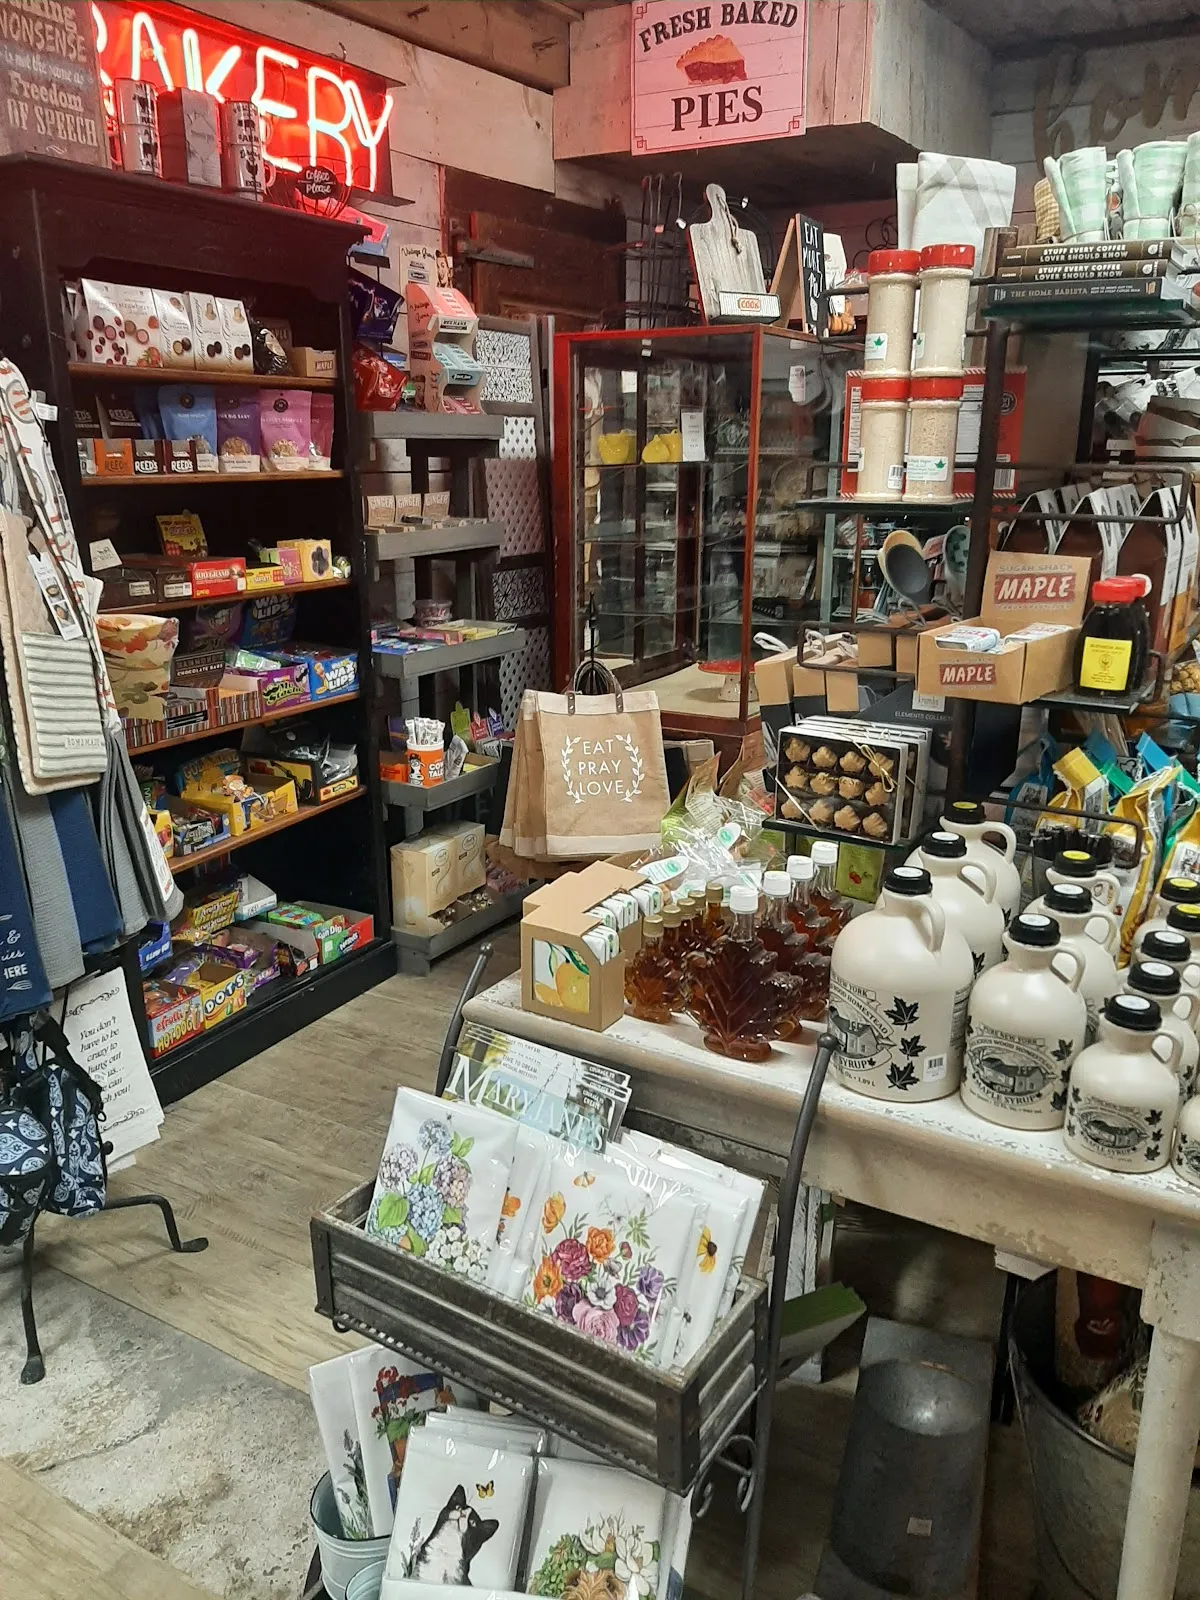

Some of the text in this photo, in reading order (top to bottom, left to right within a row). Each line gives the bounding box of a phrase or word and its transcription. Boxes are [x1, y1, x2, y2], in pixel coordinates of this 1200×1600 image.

[638, 1, 798, 52] FRESH BAKED
[8, 70, 84, 112] Freedom
[671, 86, 763, 132] PIES
[34, 105, 98, 147] SPEECH
[305, 169, 330, 182] coffee
[306, 182, 332, 195] please
[804, 222, 819, 249] EAT
[1040, 250, 1128, 263] LOVER SHOULD KNOW
[1043, 244, 1126, 255] STUFF EVERY COFFEE
[803, 247, 821, 273] MORE
[1035, 270, 1123, 281] LOVER SHOULD KNOW
[1038, 263, 1121, 274] STUFF EVERY COFFEE
[1011, 290, 1027, 298] THE
[1029, 289, 1052, 297] HOME
[1055, 287, 1088, 296] BARISTA
[740, 299, 760, 310] COOK
[370, 496, 394, 509] GINGER
[397, 495, 421, 507] GINGER
[425, 494, 448, 505] GINGER
[997, 575, 1073, 600] MAPLE
[257, 601, 290, 620] LIPS
[177, 666, 208, 677] CHOCOLATE
[325, 663, 355, 681] WAX
[942, 665, 993, 683] MAPLE
[328, 671, 355, 689] LIPS
[895, 710, 924, 719] ELEMENTS
[583, 739, 615, 755] EAT
[578, 759, 621, 776] PRAY
[580, 779, 624, 796] LOVE
[329, 923, 343, 936] Dip
[848, 982, 868, 997] YORK
[847, 994, 888, 1035] HOMESTEAD
[80, 1015, 116, 1041] You don't
[80, 1028, 120, 1053] have to be
[87, 1041, 118, 1063] crazy to
[87, 1051, 122, 1074] hang out
[520, 1061, 538, 1074] DREAM
[840, 1058, 867, 1070] SYRUP
[108, 1077, 122, 1090] can
[112, 1084, 131, 1102] you!
[1004, 1093, 1036, 1105] SYRUP
